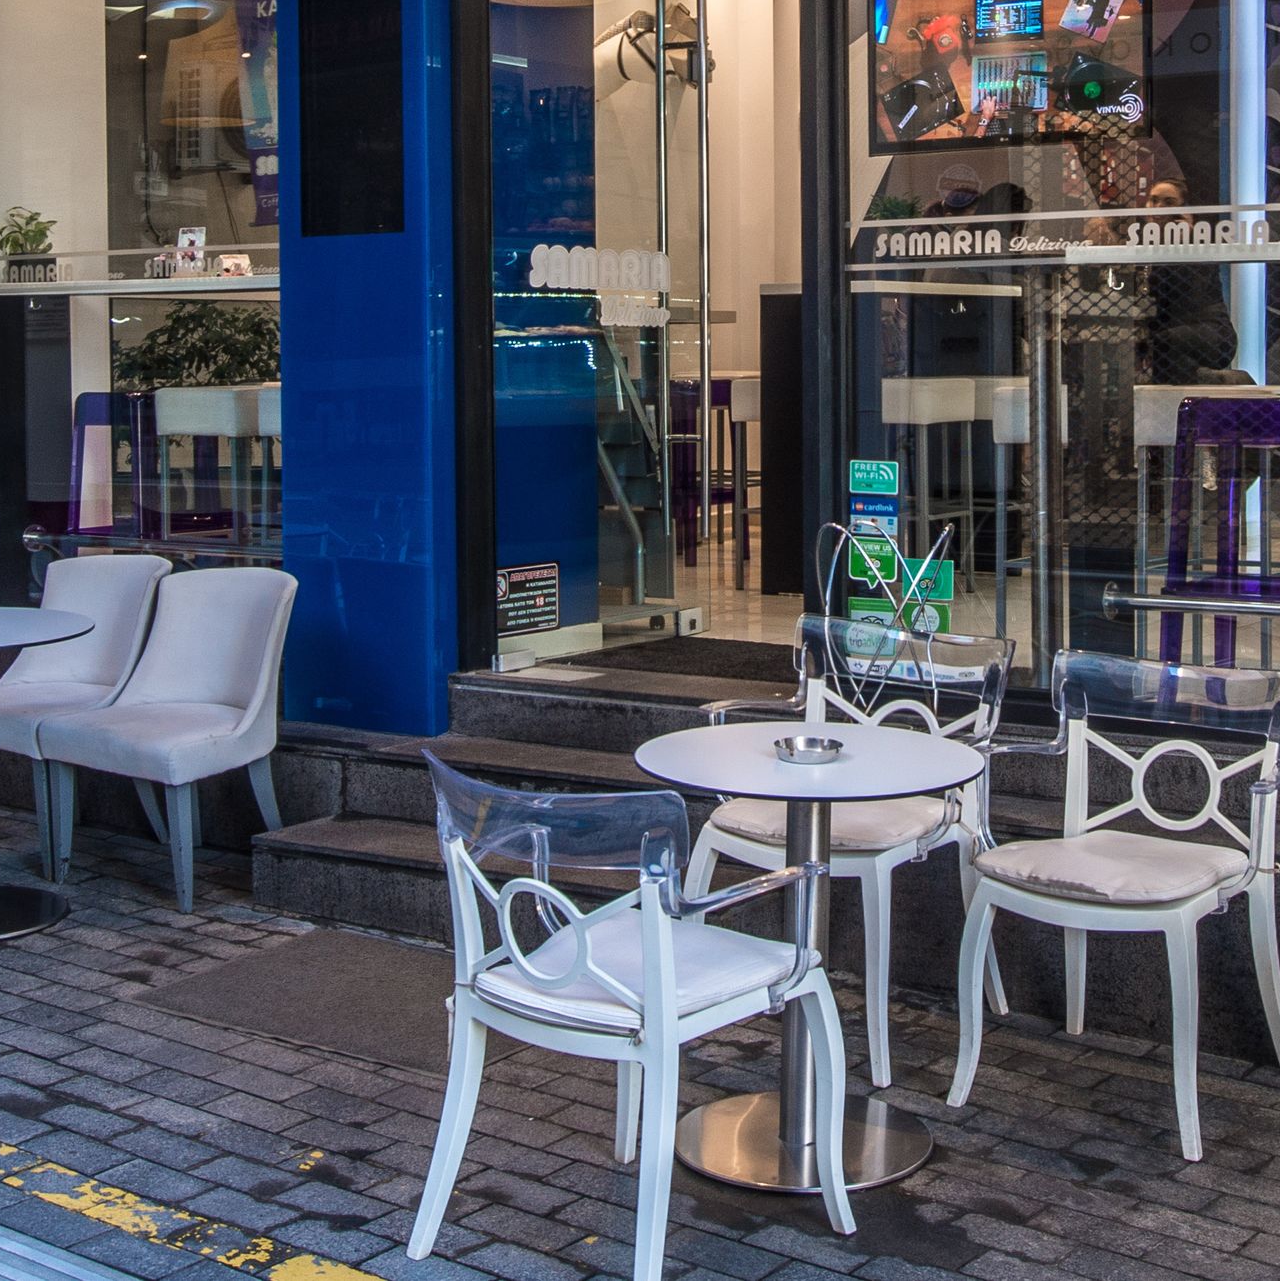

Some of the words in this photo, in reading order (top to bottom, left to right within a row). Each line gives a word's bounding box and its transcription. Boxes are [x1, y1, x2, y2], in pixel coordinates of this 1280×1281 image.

[1126, 219, 1270, 246] SAMARIA
[875, 229, 1002, 257] SAMARIA
[1009, 236, 1094, 253] Delizioso
[1, 263, 73, 282] SAMARIA
[530, 244, 670, 292] SAMARIA
[854, 463, 878, 471] FREE
[854, 472, 879, 480] WI-FI
[864, 503, 894, 512] cardlink
[536, 597, 544, 606] 18
